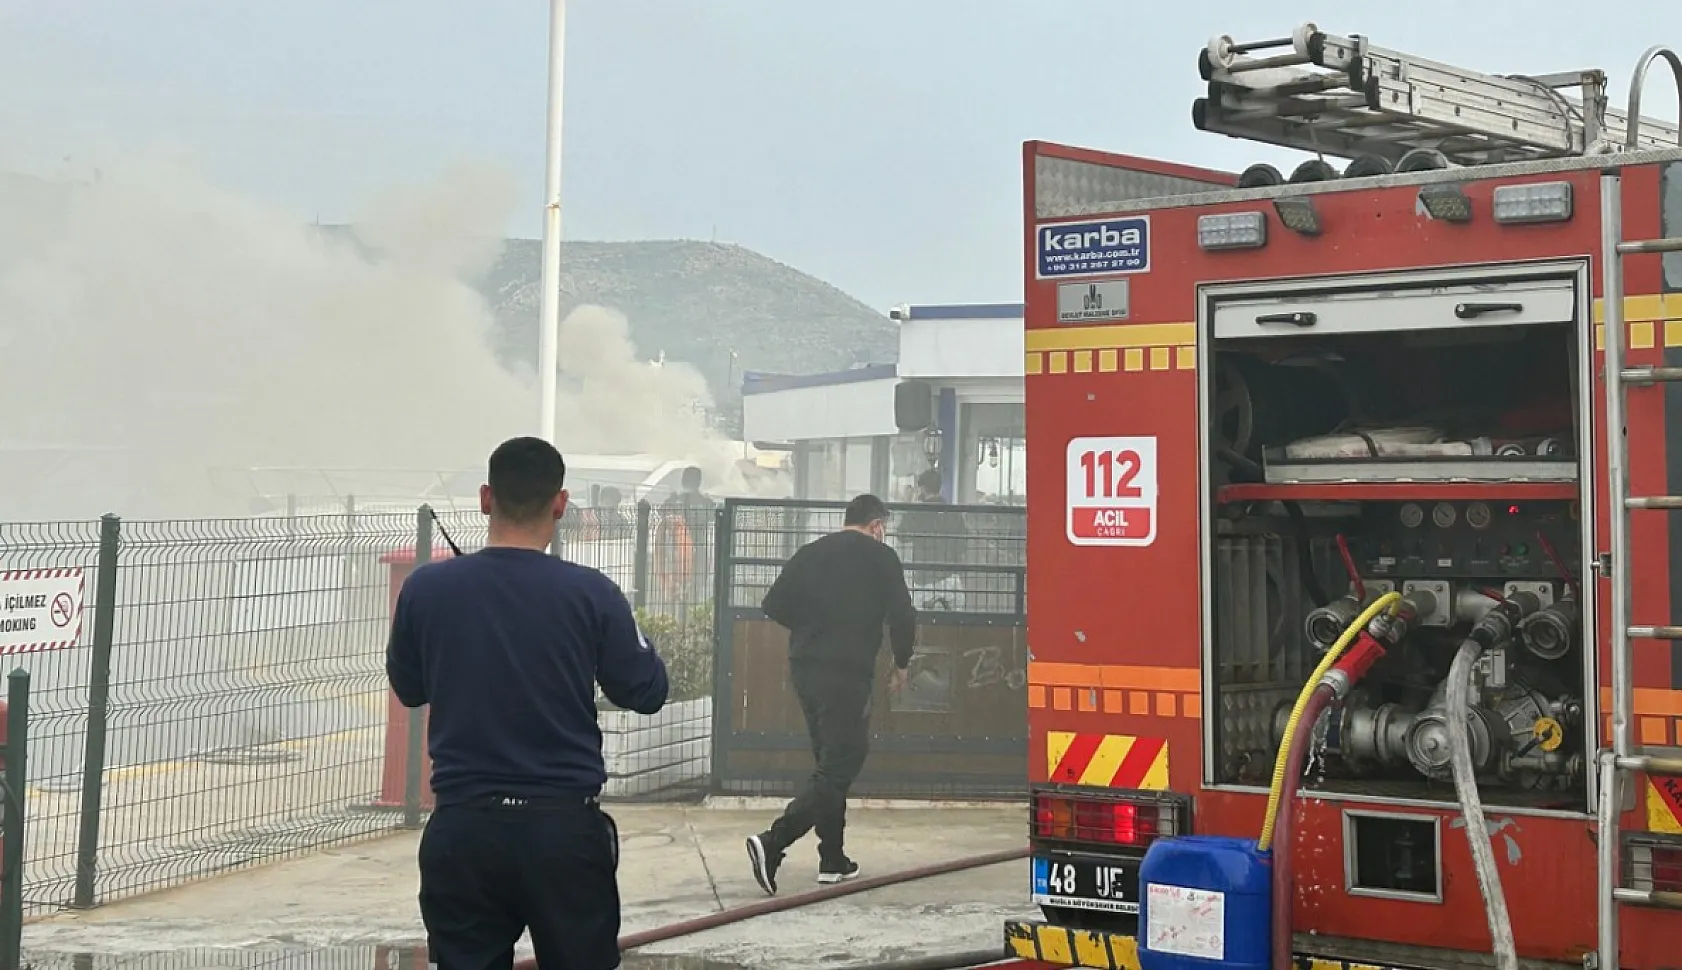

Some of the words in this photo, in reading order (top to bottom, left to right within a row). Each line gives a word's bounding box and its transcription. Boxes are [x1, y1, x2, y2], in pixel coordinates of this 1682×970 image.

[1045, 225, 1141, 251] karba
[1045, 248, 1140, 262] www.karba.com.tr
[1080, 450, 1142, 498] 112
[5, 593, 46, 613] İÇİLMEZ
[1050, 863, 1076, 894] 48
[1095, 866, 1123, 899] UE
